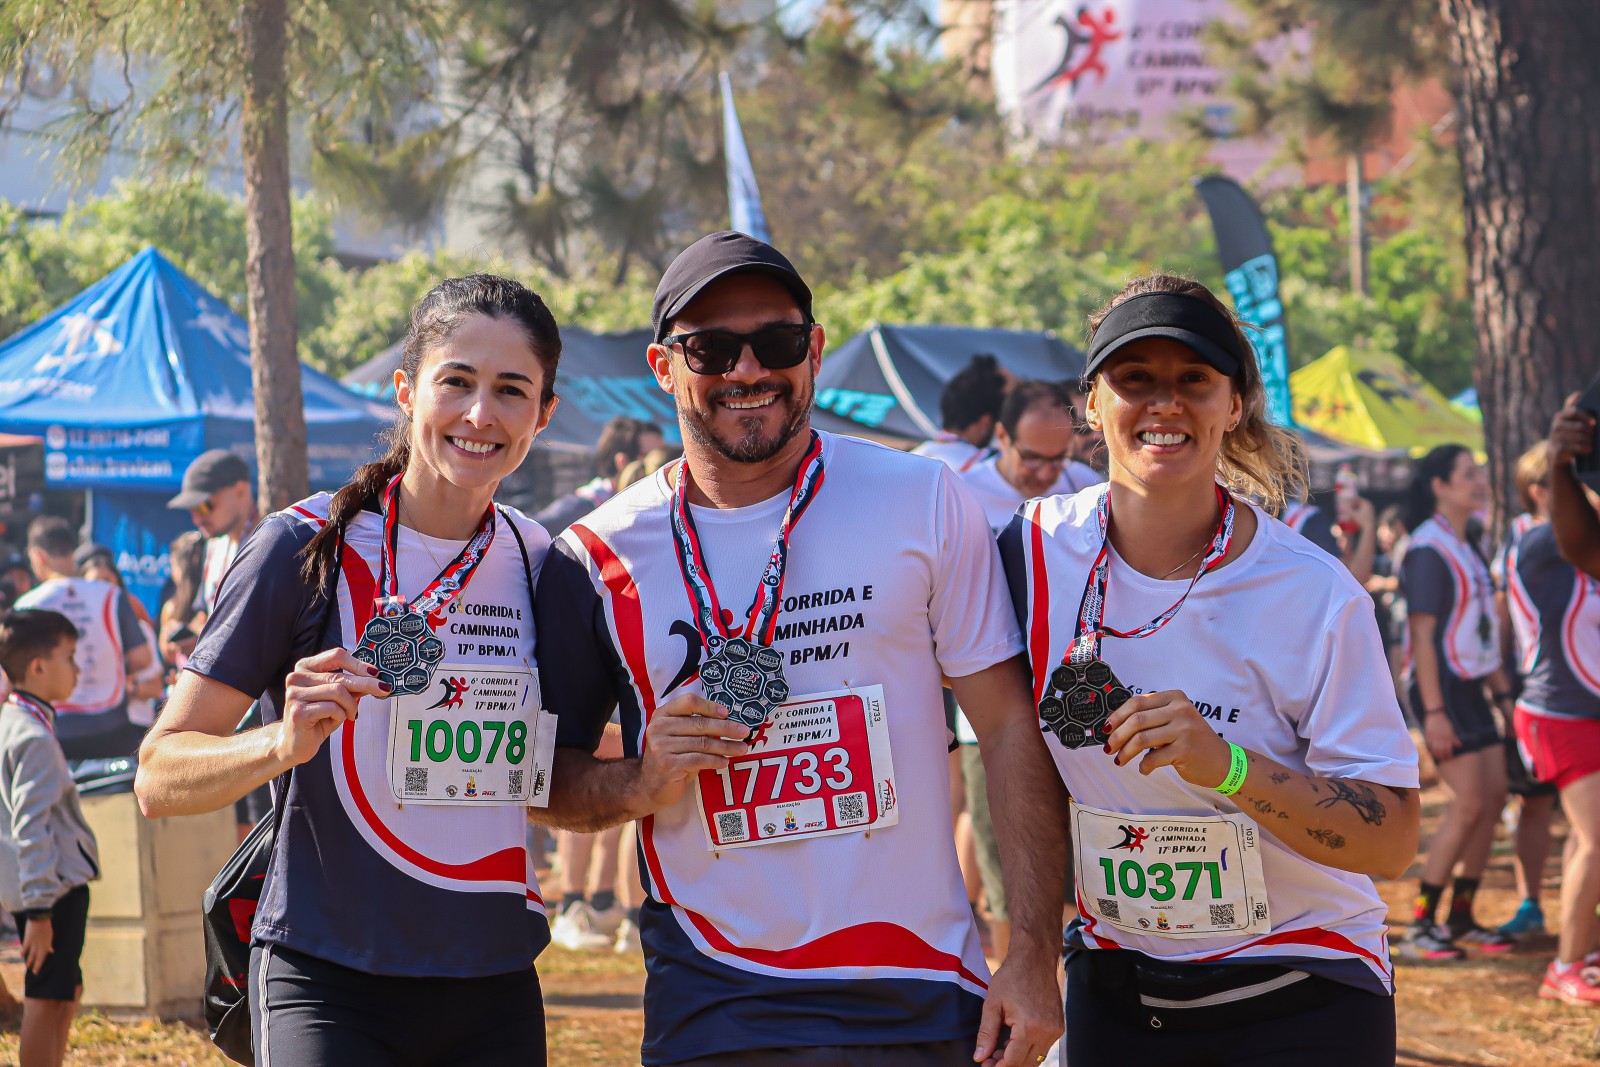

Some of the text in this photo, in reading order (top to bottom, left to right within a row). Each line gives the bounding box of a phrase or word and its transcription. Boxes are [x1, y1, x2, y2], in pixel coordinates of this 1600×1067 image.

[863, 585, 873, 600] E
[465, 603, 514, 619] CORRIDA
[516, 609, 522, 621] E
[1087, 586, 1097, 627] CAMINHADA
[450, 623, 520, 639] CAMINHADA
[774, 612, 865, 641] MINHADA
[457, 643, 517, 657] 17º BPM/I
[790, 641, 849, 666] BPM/I
[481, 678, 513, 686] CORRIDA
[514, 678, 519, 686] E
[473, 689, 517, 697] CAMINHADA
[487, 702, 516, 711] BPM/I
[786, 706, 824, 718] CORRIDA
[827, 704, 833, 712] E
[871, 699, 881, 722] 17733
[1227, 708, 1240, 723] E
[778, 717, 832, 731] CAMINHADA
[408, 719, 528, 765] 10078
[796, 728, 833, 743] BPM/I
[715, 746, 853, 807] 17733
[1162, 825, 1199, 833] CORRIDA
[1246, 827, 1254, 848] 10371
[1172, 845, 1207, 854] BPM/I
[1099, 856, 1223, 901] 10371
